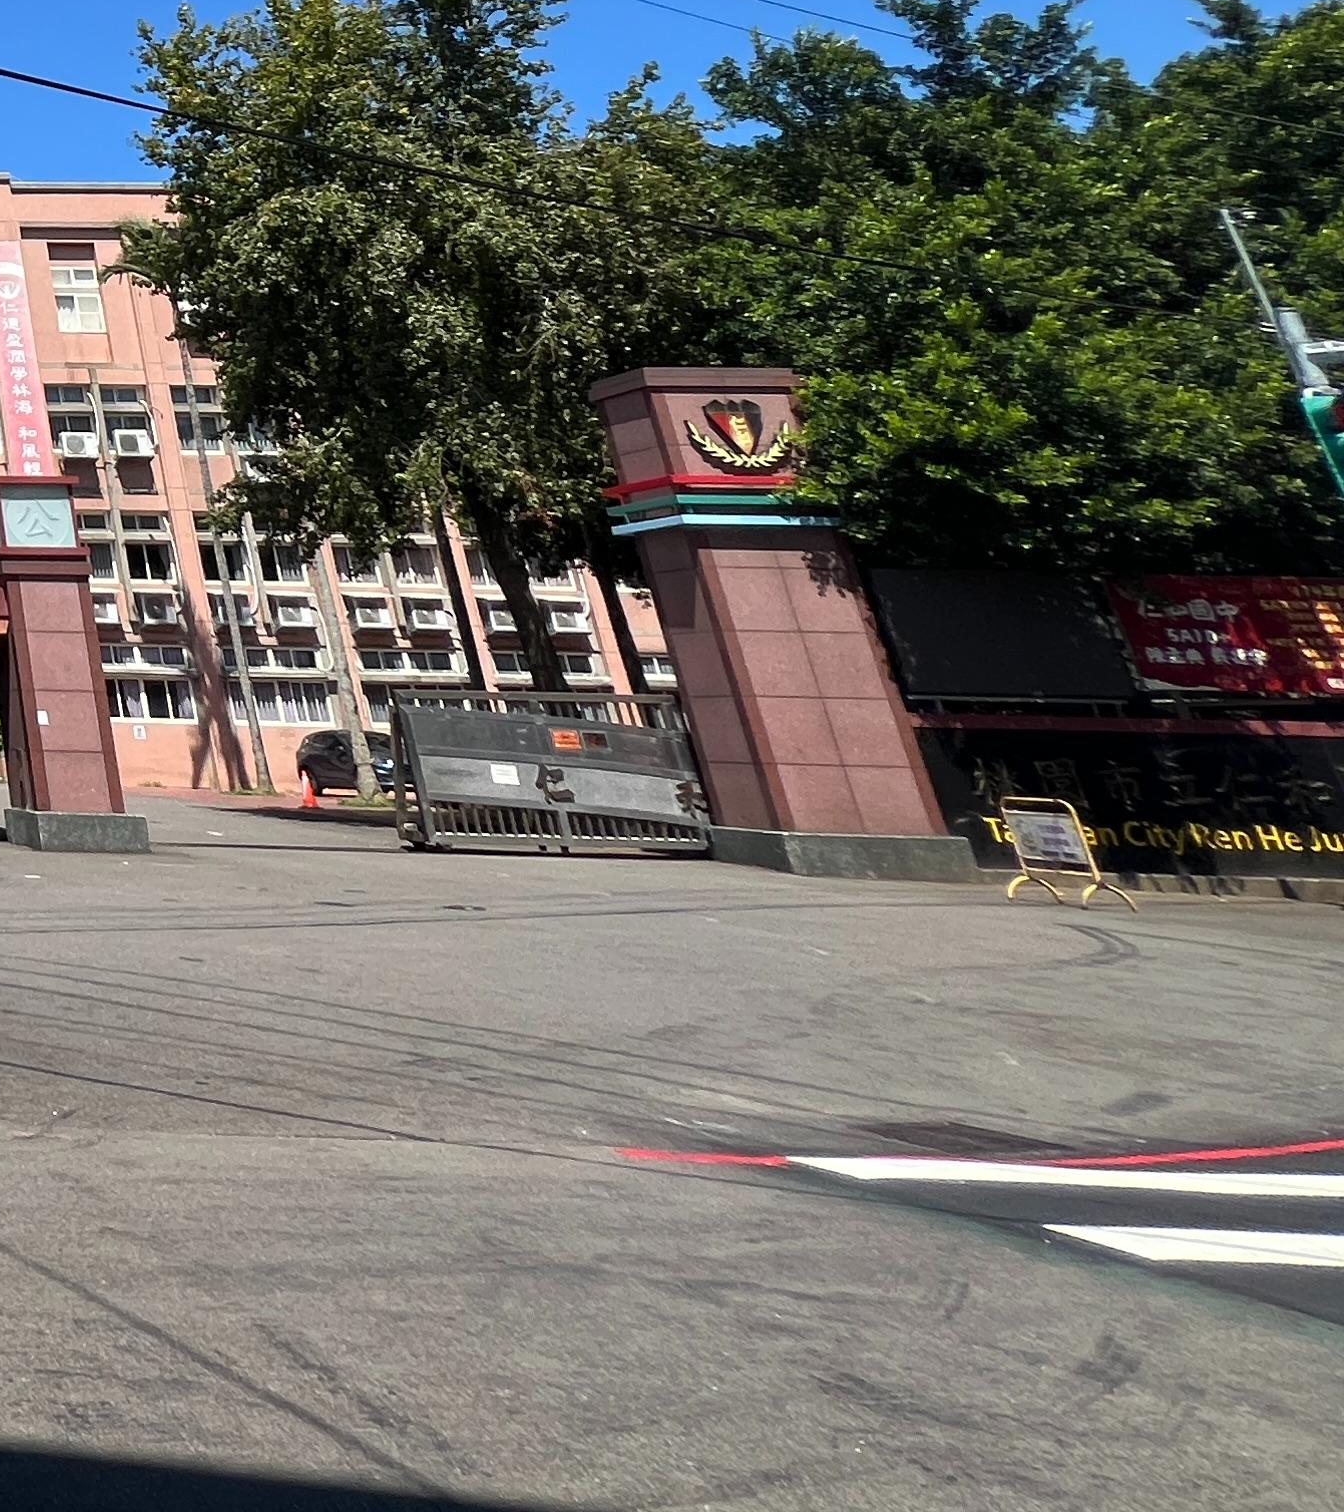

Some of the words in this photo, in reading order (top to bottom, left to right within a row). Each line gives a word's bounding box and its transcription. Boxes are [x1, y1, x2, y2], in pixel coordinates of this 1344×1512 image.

[17, 499, 61, 538] 公
[1123, 820, 1184, 855] City
[1254, 824, 1304, 852] He
